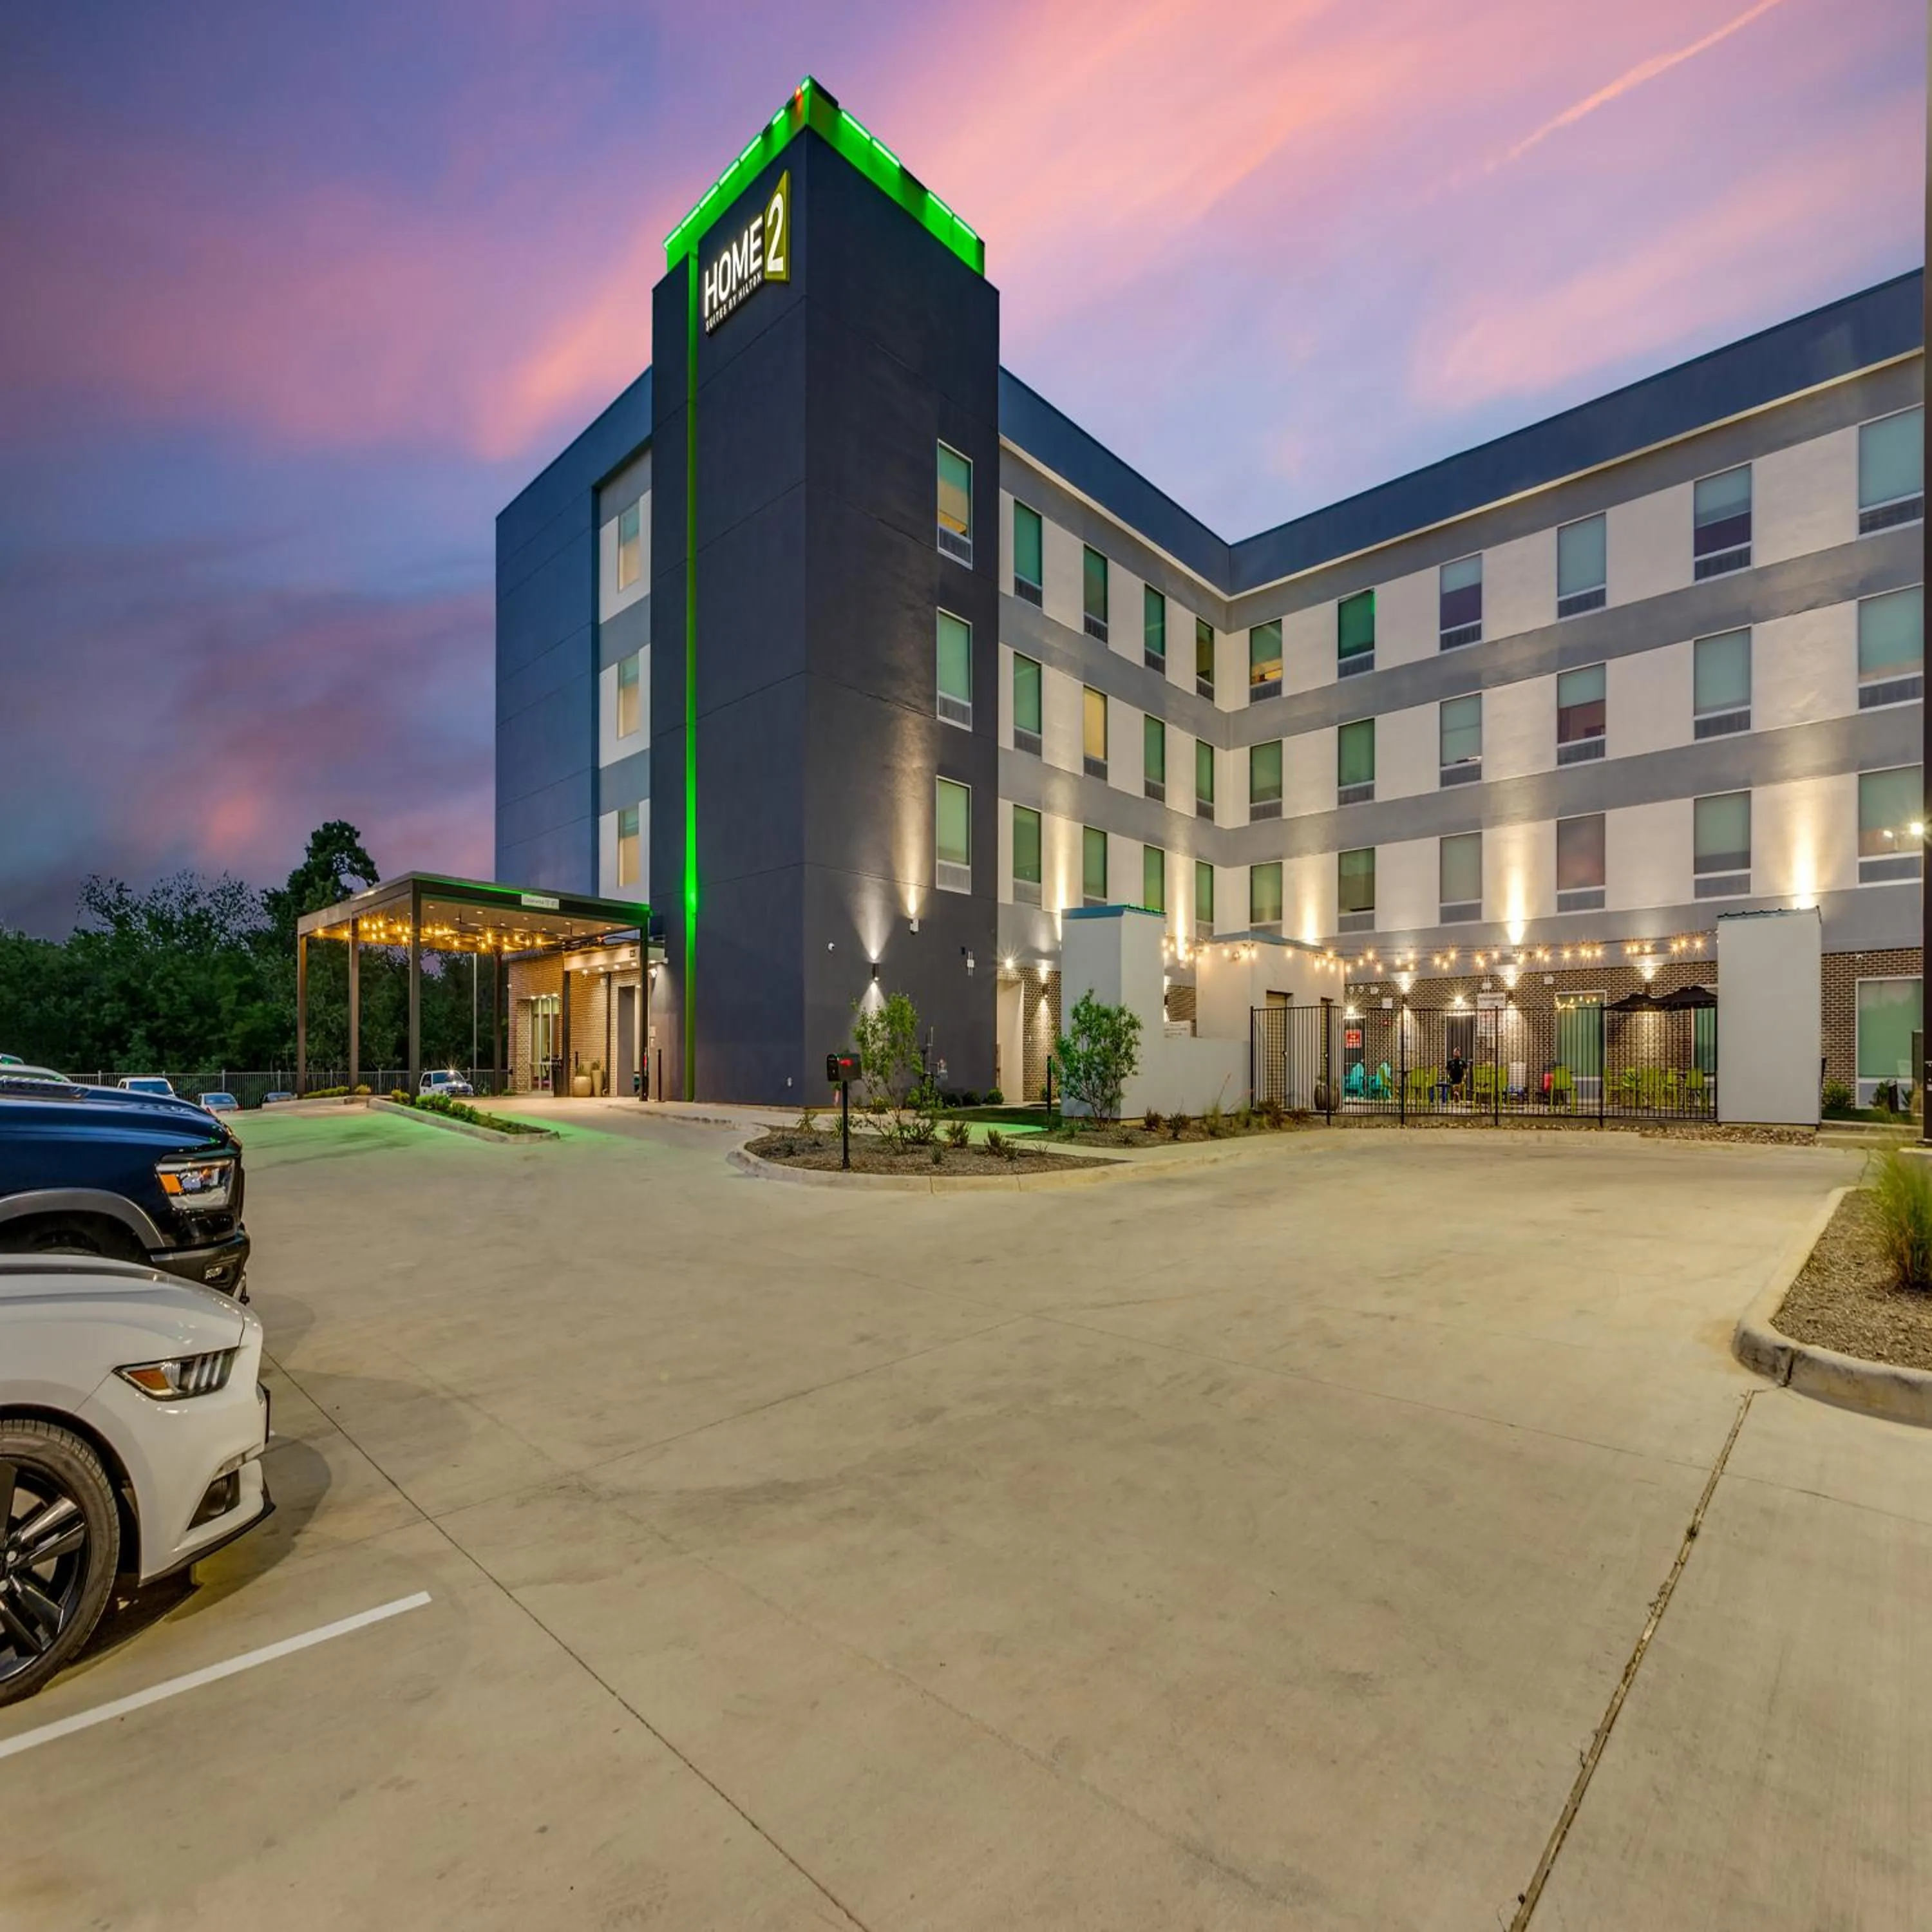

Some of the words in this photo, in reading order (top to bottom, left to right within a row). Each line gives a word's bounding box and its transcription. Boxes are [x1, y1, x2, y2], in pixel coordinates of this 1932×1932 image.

[705, 214, 762, 318] HOME
[767, 193, 784, 272] 2
[705, 304, 727, 332] SUITES
[728, 294, 737, 310] BY
[738, 270, 762, 302] HILTON
